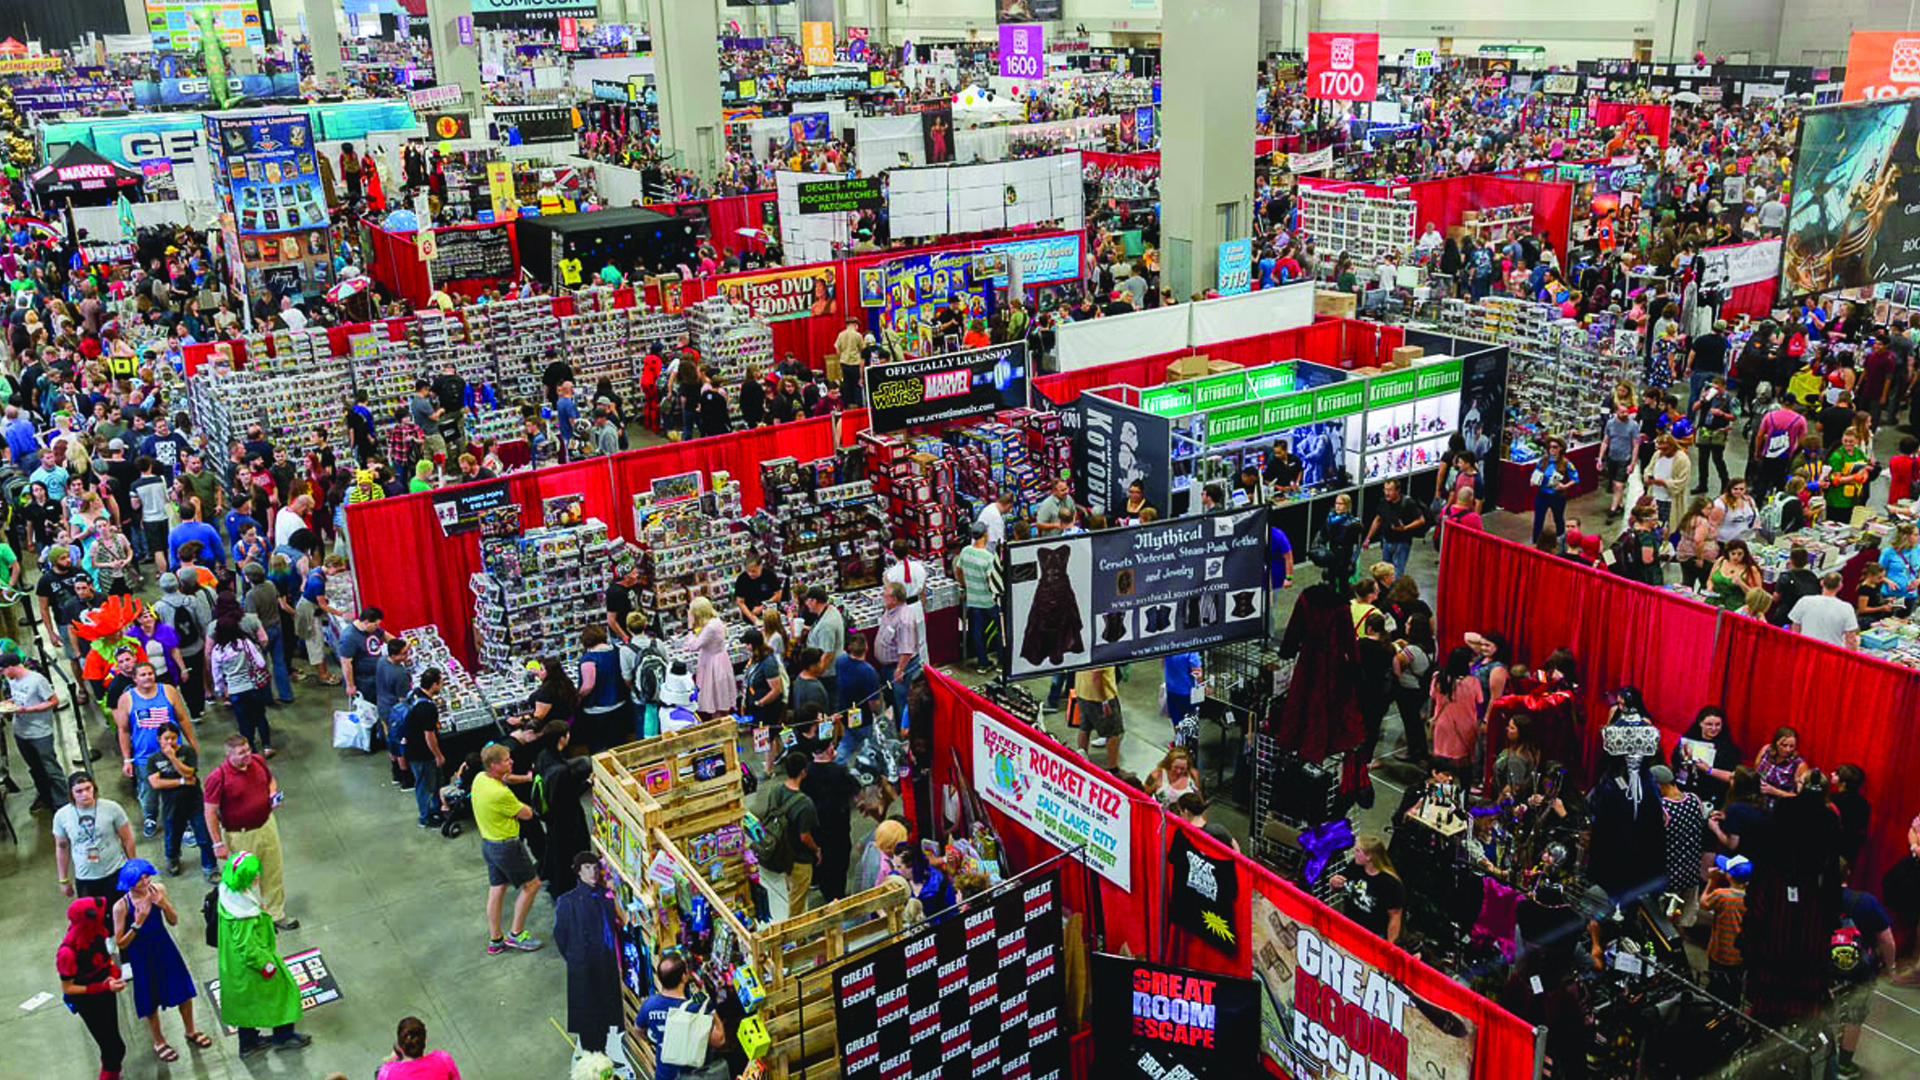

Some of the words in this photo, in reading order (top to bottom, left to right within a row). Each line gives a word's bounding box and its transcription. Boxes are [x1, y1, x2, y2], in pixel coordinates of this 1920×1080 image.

[526, 12, 554, 20] PROUD
[556, 10, 595, 18] SPONSOR
[1006, 56, 1037, 76] 1600
[179, 78, 243, 94] GEO
[1319, 72, 1364, 96] 1700
[58, 165, 115, 180] MARVEL
[846, 180, 868, 189] PINS
[818, 201, 858, 212] PATCHES
[742, 280, 779, 302] Free
[781, 276, 814, 295] DVD
[885, 356, 954, 378] OFFICIALLY
[957, 348, 1012, 366] LICENSED
[878, 377, 922, 396] STAR
[925, 371, 971, 400] MARVEL
[1197, 383, 1244, 403] KOTOBUKIYA
[872, 389, 923, 410] WARS
[1264, 402, 1312, 425] KOTOBUKIYA
[1209, 415, 1259, 437] KOTOBUKIYA
[1087, 408, 1113, 507] KOTOBU
[1133, 524, 1203, 551] Mythical
[1146, 570, 1161, 583] and
[983, 725, 1023, 755] ROCKET
[1029, 747, 1086, 798] ROCKET
[1089, 780, 1122, 820] FIZZ
[1037, 793, 1061, 817] SALT
[1063, 809, 1090, 836] LAKE
[1092, 827, 1117, 851] CITY
[1023, 880, 1053, 903] GREAT
[964, 906, 995, 930] GREAT
[1024, 901, 1052, 923] ESCAPE
[905, 933, 937, 959] GREAT
[966, 928, 996, 951] ESCAPE
[997, 926, 1026, 950] GREAT
[906, 956, 938, 979] ESCAPE
[938, 954, 969, 980] GREAT
[998, 947, 1026, 970] ESCAPE
[1026, 944, 1054, 967] GREAT
[841, 962, 876, 988] GREAT
[938, 975, 969, 999] ESCAPE
[968, 972, 999, 996] GREAT
[1026, 964, 1055, 986] ESCAPE
[1133, 967, 1217, 1005] GREAT
[1296, 928, 1411, 1034] GREAT
[842, 985, 876, 1008] ESCAPE
[876, 983, 909, 1008] GREAT
[969, 993, 999, 1016] ESCAPE
[1000, 990, 1029, 1014] GREAT
[877, 1005, 910, 1028] ESCAPE
[909, 1001, 941, 1025] GREAT
[1000, 1010, 1029, 1033] ESCAPE
[1027, 1006, 1058, 1030] GREAT
[1132, 990, 1216, 1030] ROOM
[910, 1022, 941, 1045] ESCAPE
[941, 1019, 971, 1044] GREAT
[1132, 1016, 1215, 1050] ESCAPE
[1294, 966, 1410, 1080] ROOM
[846, 1030, 880, 1056] GREAT
[971, 1035, 1001, 1060] GREAT
[1028, 1027, 1058, 1048] ESCAPE
[880, 1049, 913, 1074] GREAT
[942, 1040, 972, 1063] ESCAPE
[847, 1052, 880, 1076] ESCAPE
[972, 1056, 1001, 1079] ESCAPE
[1002, 1052, 1031, 1076] GREAT
